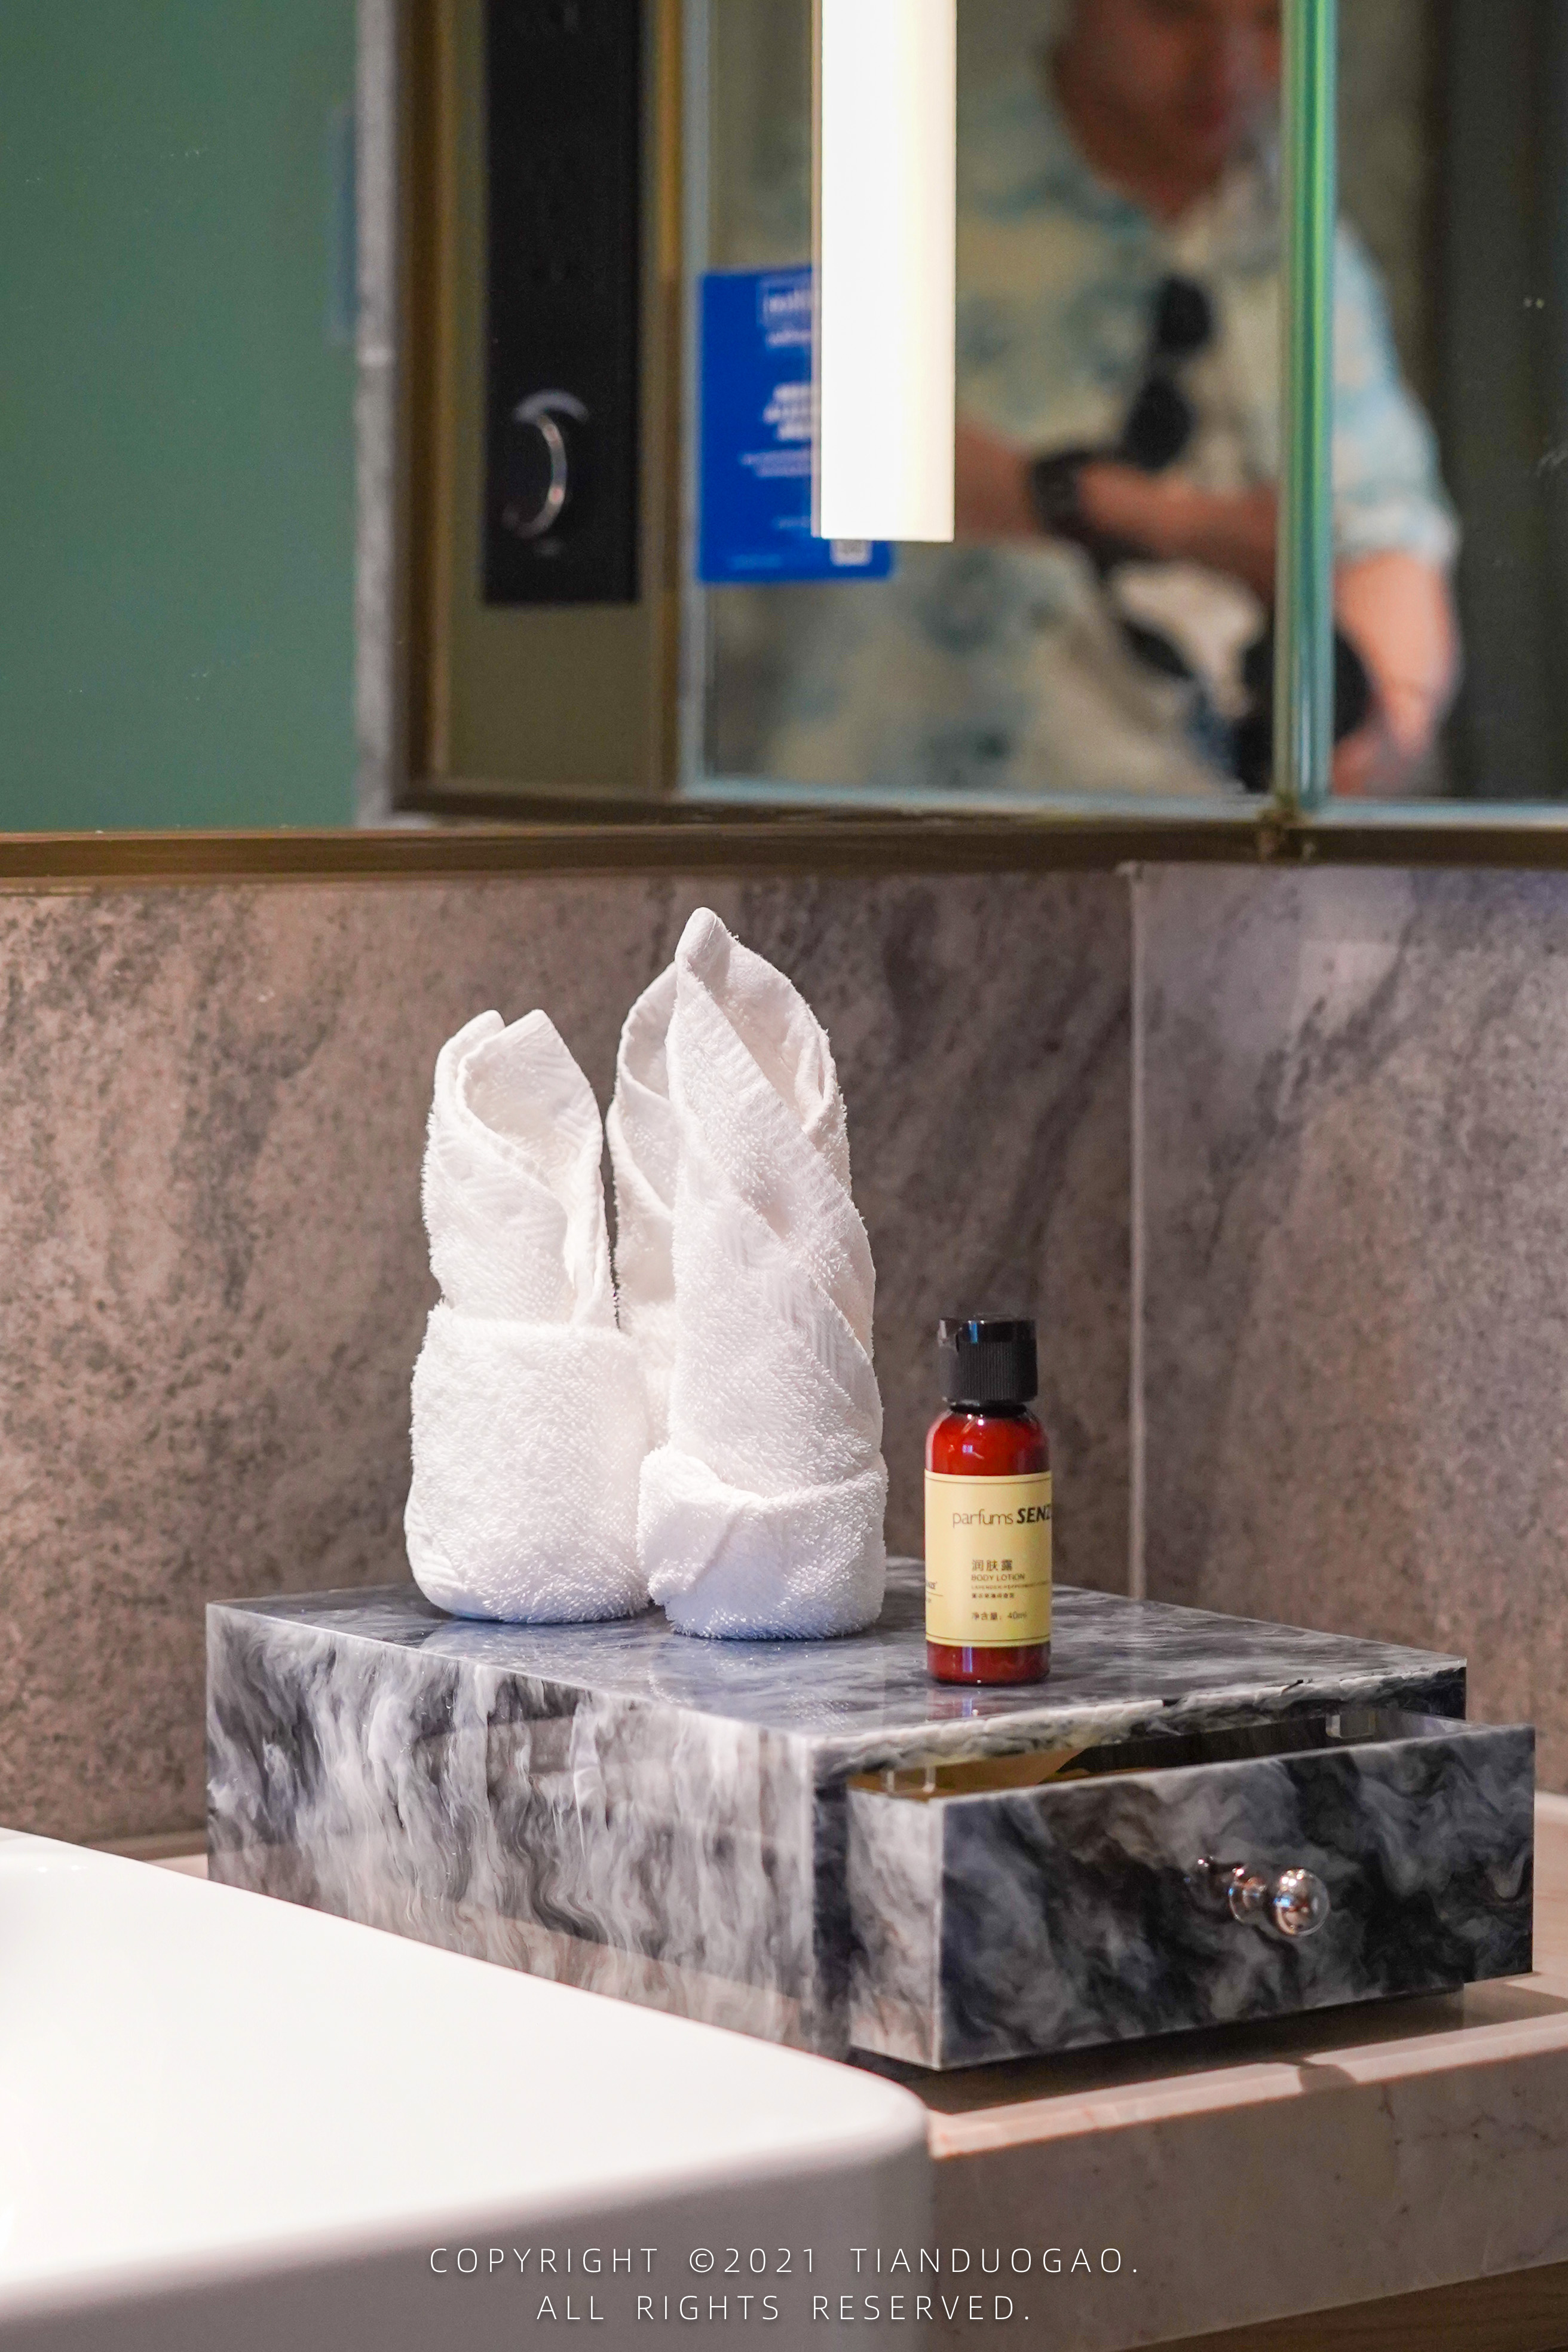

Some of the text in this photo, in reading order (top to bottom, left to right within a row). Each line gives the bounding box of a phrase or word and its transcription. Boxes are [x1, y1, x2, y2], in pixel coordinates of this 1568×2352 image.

[953, 1509, 1013, 1528] parfums
[972, 1559, 1013, 1571] 润肤露
[997, 1573, 1025, 1582] LOTION
